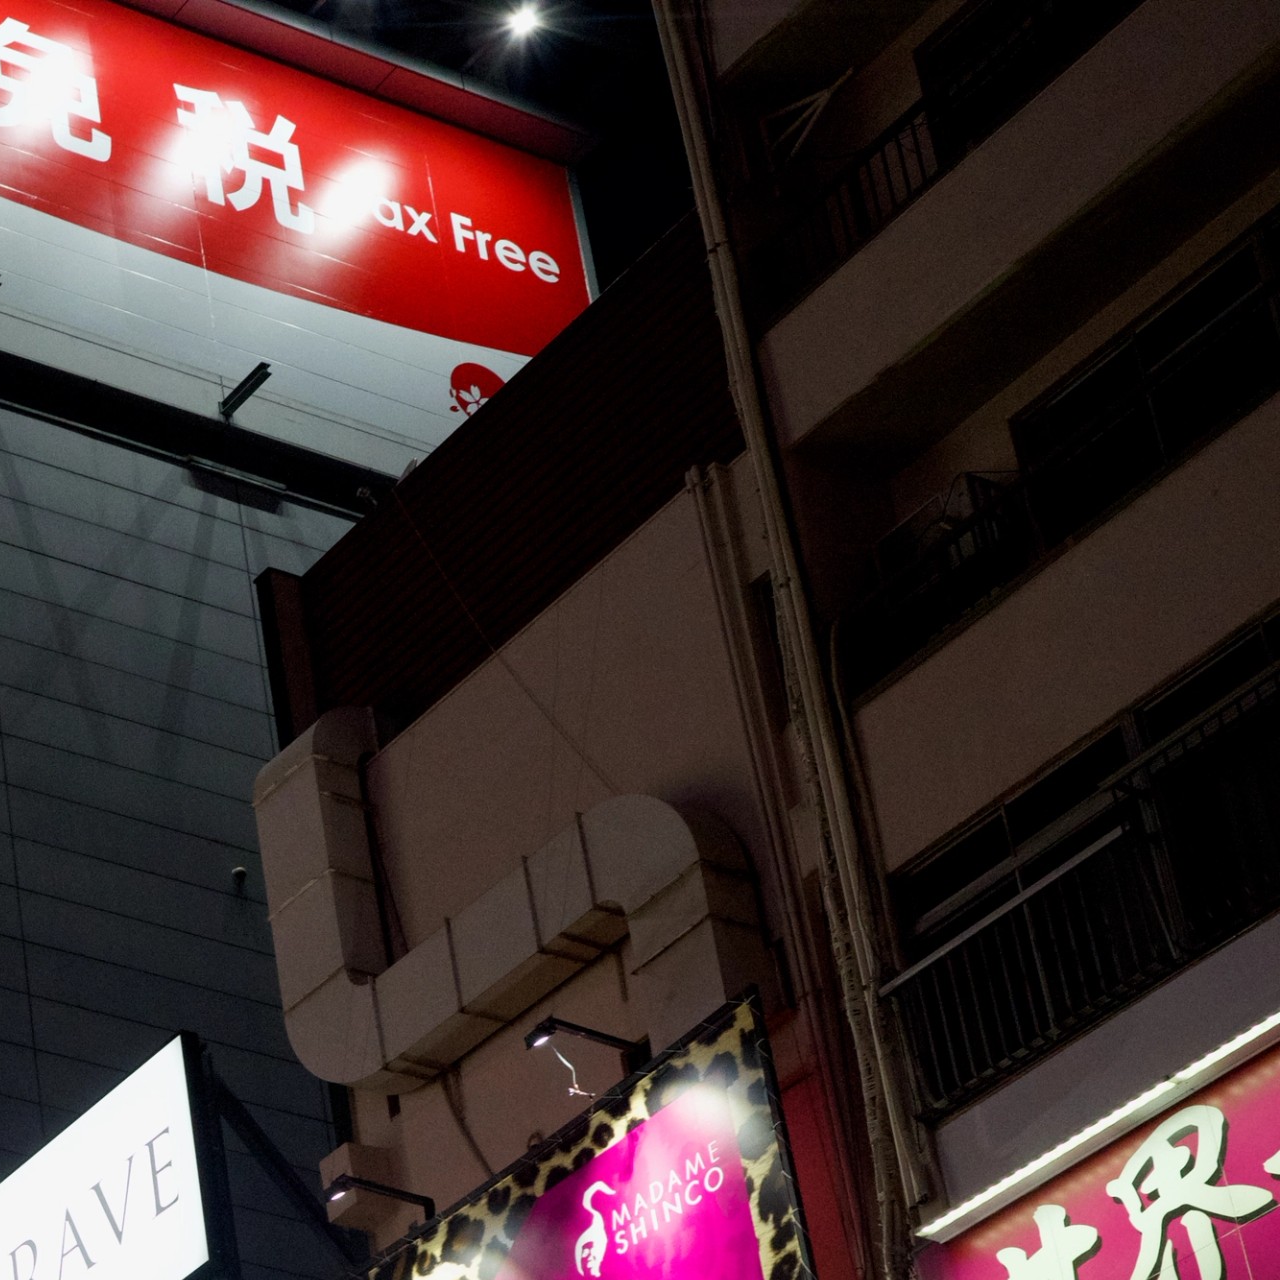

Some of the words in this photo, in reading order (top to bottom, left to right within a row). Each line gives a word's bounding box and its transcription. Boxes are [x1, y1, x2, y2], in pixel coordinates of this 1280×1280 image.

[450, 211, 561, 284] Free
[612, 1140, 721, 1232] MADAME
[615, 1166, 725, 1255] SHINCO
